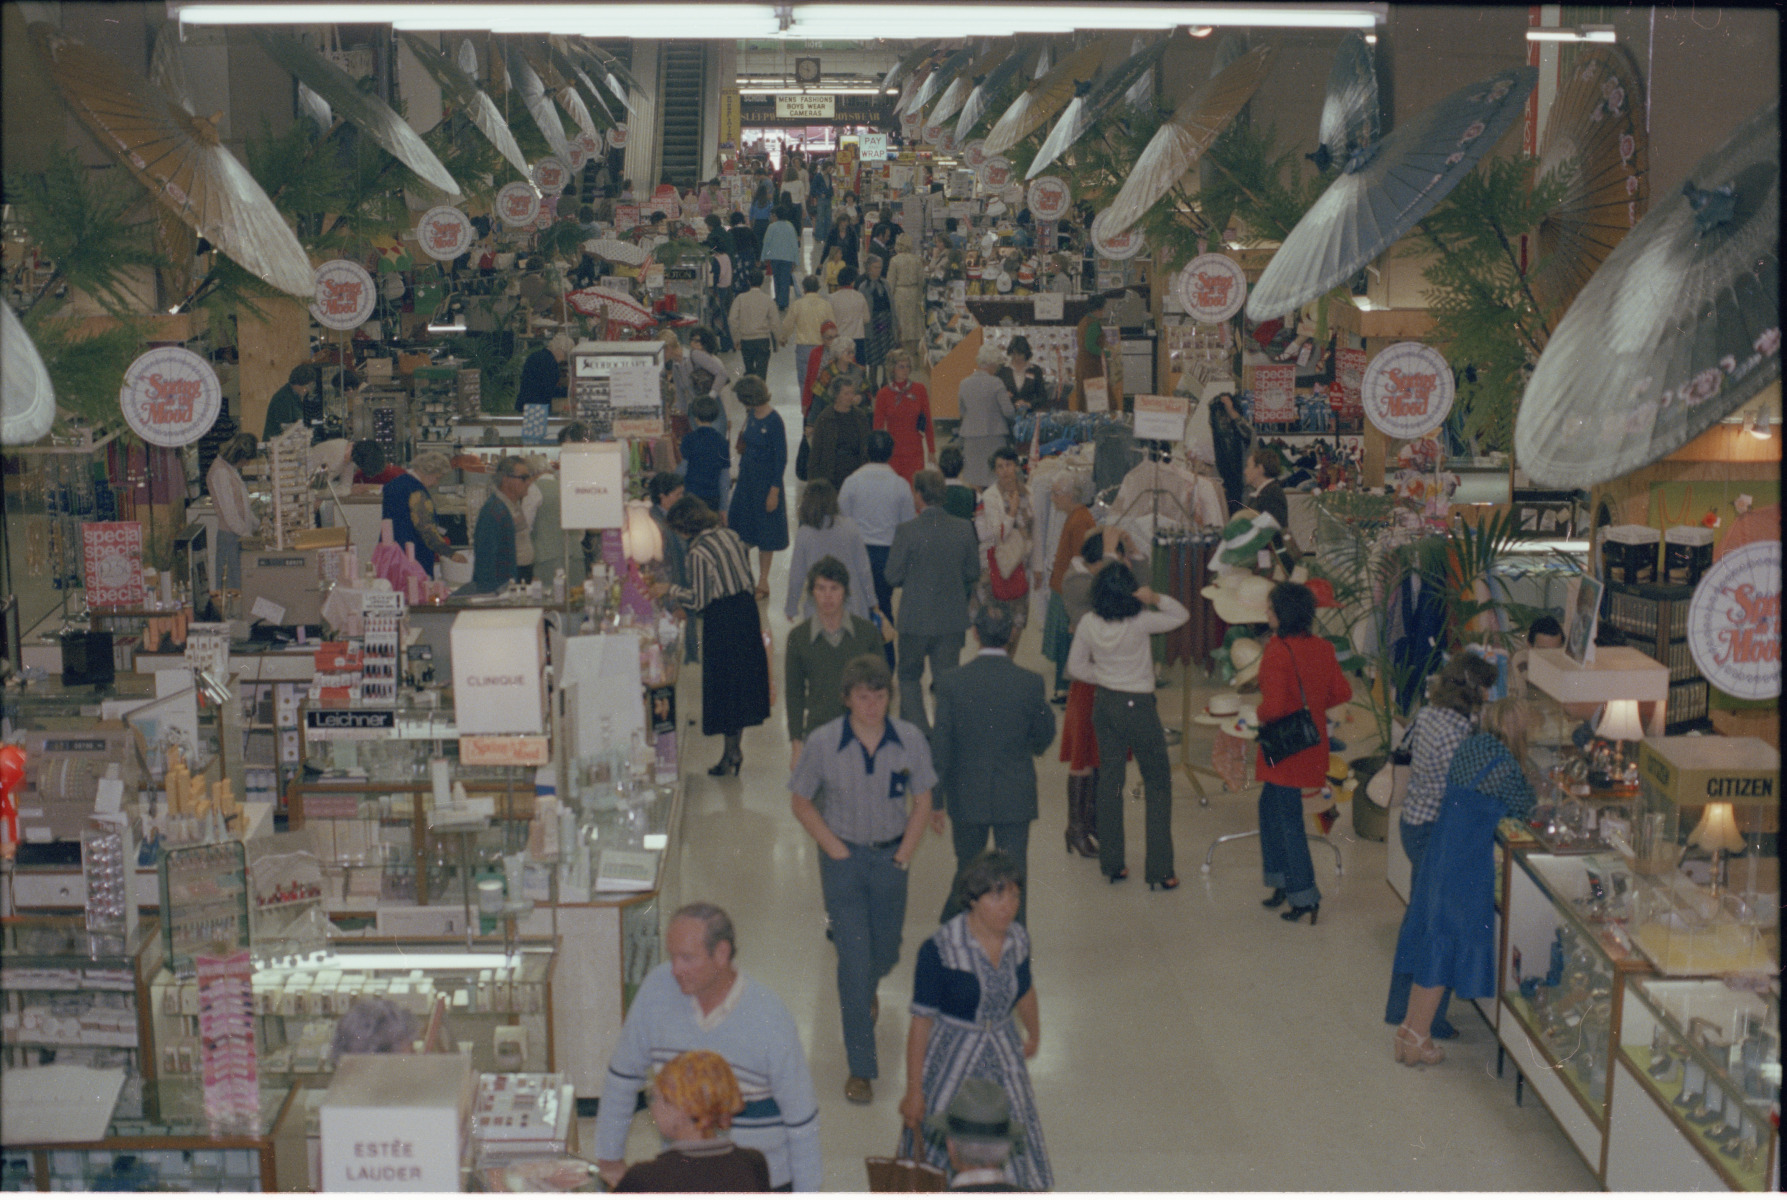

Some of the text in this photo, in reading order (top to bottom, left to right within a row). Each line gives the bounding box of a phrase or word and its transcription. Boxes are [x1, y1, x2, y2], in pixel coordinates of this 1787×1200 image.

[864, 137, 881, 145] PAY
[861, 150, 885, 158] WRAP
[1256, 368, 1296, 380] special
[1380, 367, 1437, 393] Spring
[139, 373, 202, 400] Spring
[139, 401, 194, 425] Mood
[1255, 409, 1295, 422] special
[1378, 396, 1429, 418] Mood
[84, 525, 142, 546] special
[466, 674, 526, 687] CLINIQUE
[315, 711, 388, 726] Leichner
[1706, 777, 1773, 798] CITIZEN
[353, 1139, 414, 1158] ESTÉE
[345, 1165, 422, 1182] LAUDER
